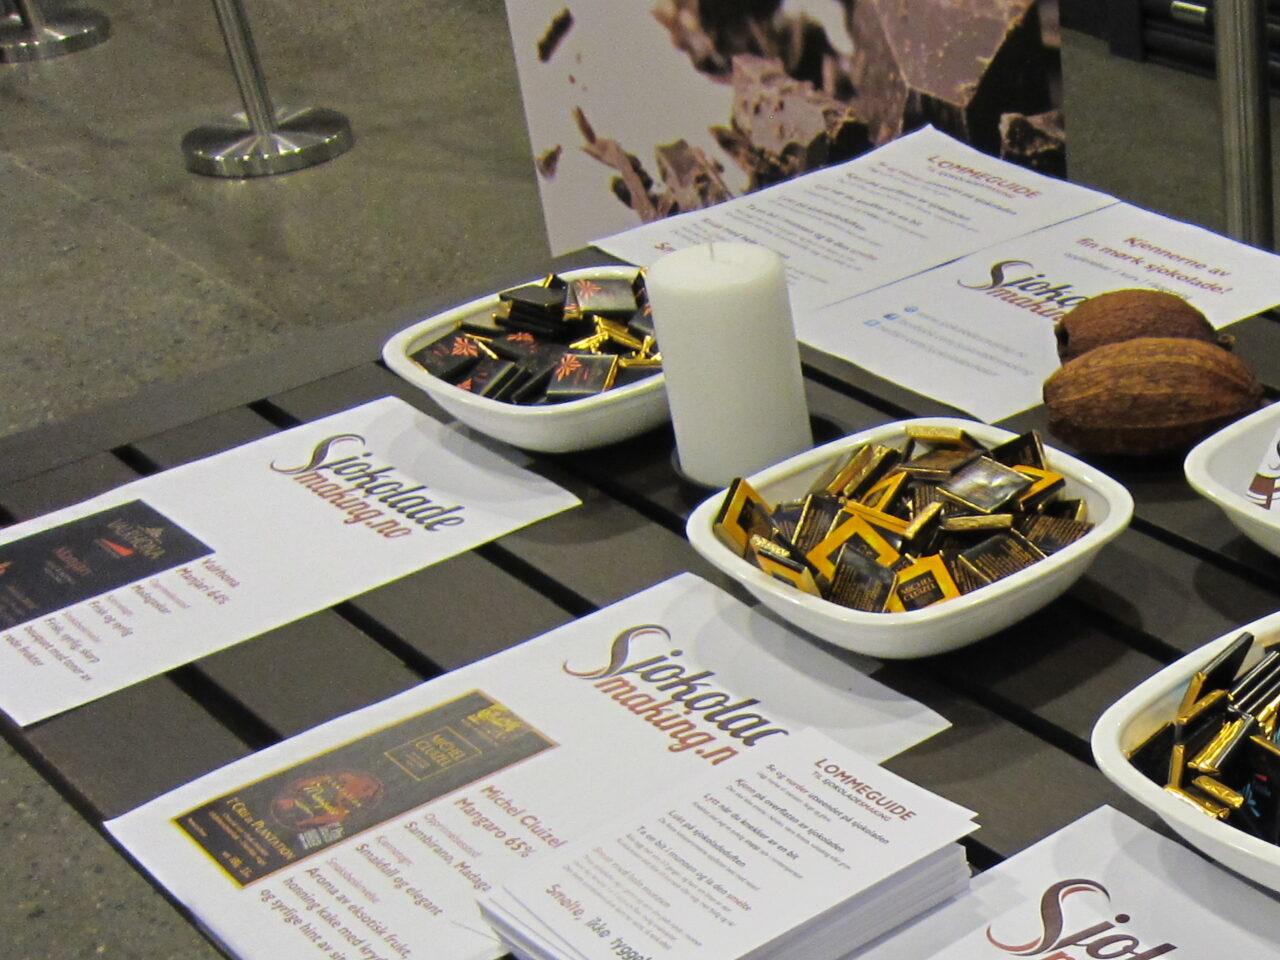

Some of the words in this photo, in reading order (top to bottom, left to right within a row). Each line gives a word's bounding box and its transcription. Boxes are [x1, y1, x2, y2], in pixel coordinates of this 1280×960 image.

[1076, 238, 1099, 248] fin
[1144, 263, 1233, 294] sjokolade!
[1124, 236, 1207, 269] Kjennerne
[1208, 268, 1231, 276] av
[270, 434, 464, 532] Sjokolade
[292, 469, 412, 539] making.no
[562, 624, 789, 747] Sjokola
[593, 676, 739, 766] making.n
[481, 785, 527, 817] Michel
[520, 814, 568, 848] Cluizel
[814, 758, 917, 821] LOMMEGUIDE
[454, 797, 507, 839] Mangaro
[505, 837, 536, 858] 65%
[306, 867, 339, 896] Aroma
[336, 891, 351, 905] av
[393, 877, 409, 889] og
[406, 887, 443, 916] elegant
[454, 861, 492, 892] Madaga
[260, 888, 276, 902] og
[318, 940, 333, 952] av
[283, 876, 321, 911] honning
[317, 906, 341, 928] kake
[338, 926, 365, 946] med
[546, 883, 585, 920] Smelte,
[584, 917, 611, 938] ikke
